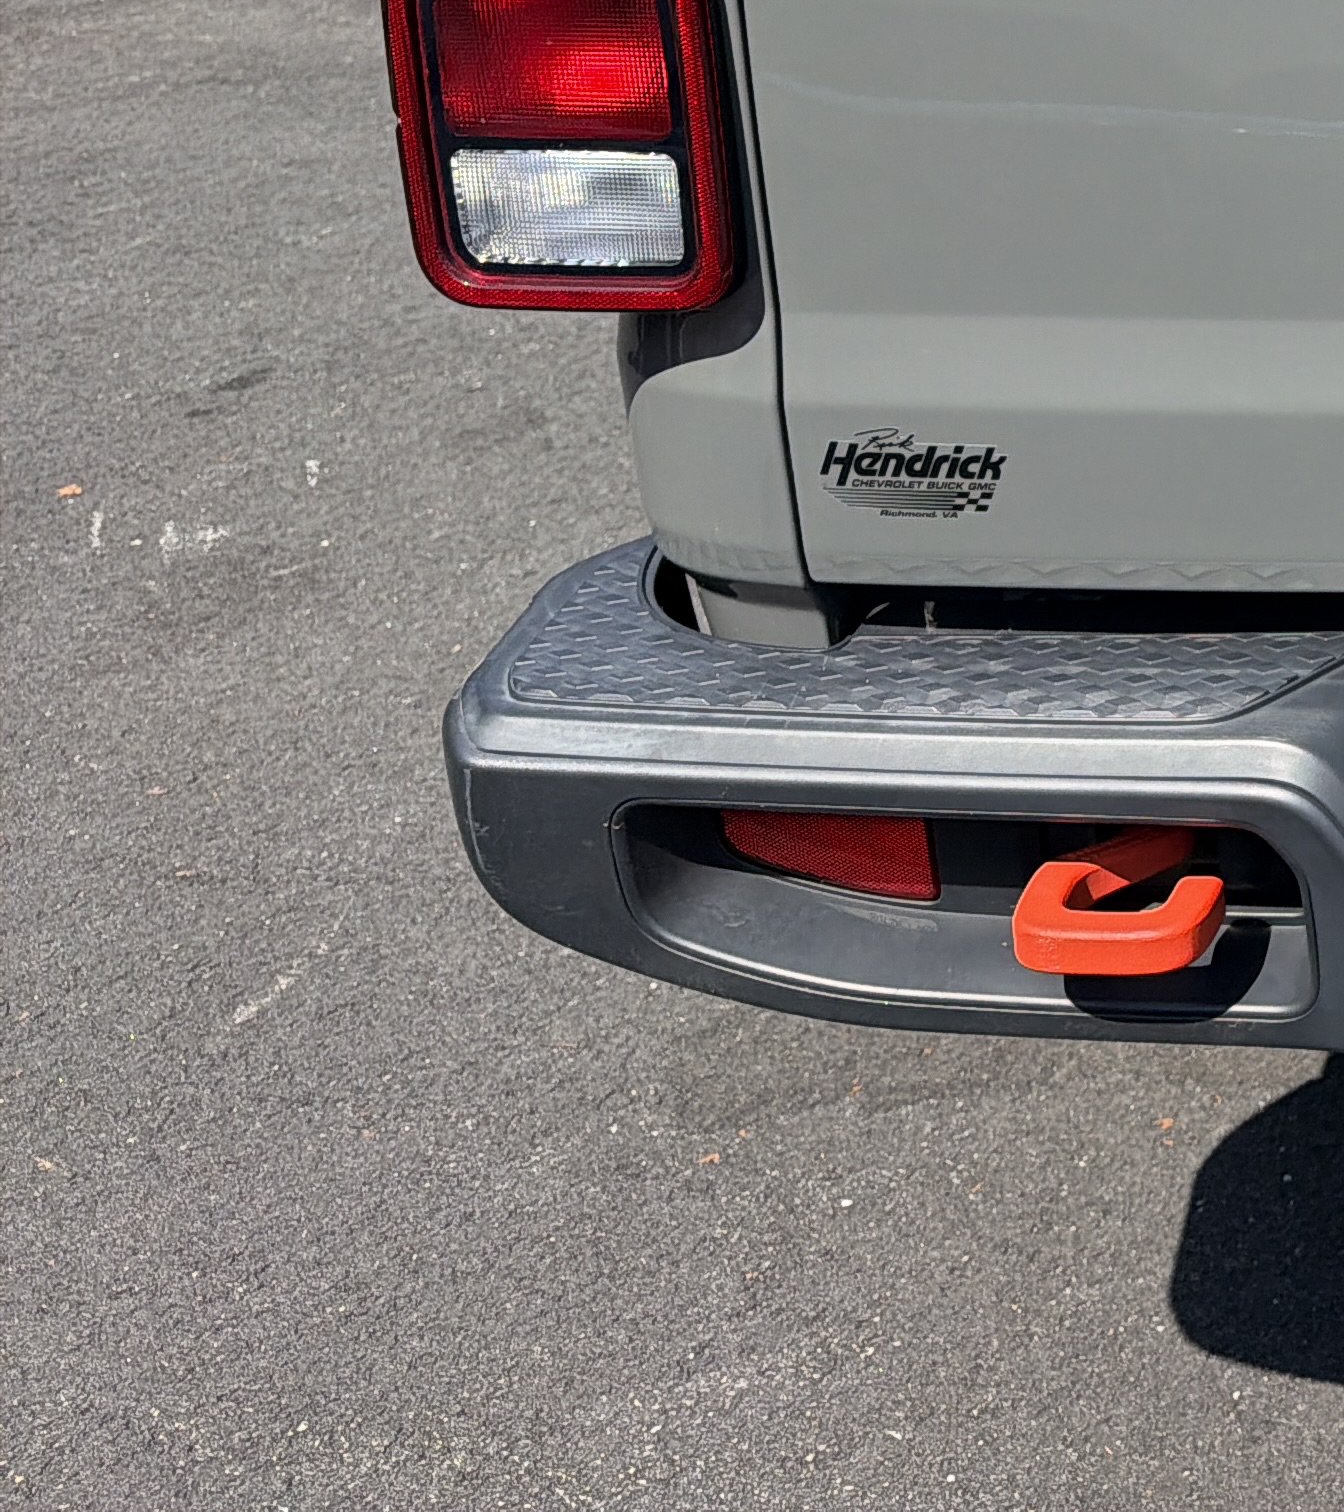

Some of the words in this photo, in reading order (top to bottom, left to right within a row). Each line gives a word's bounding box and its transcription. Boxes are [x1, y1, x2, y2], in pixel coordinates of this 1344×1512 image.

[819, 440, 1008, 487] Hendrick
[851, 478, 925, 490] CHEVROLET
[926, 481, 964, 491] BUICK
[967, 482, 997, 492] GMC
